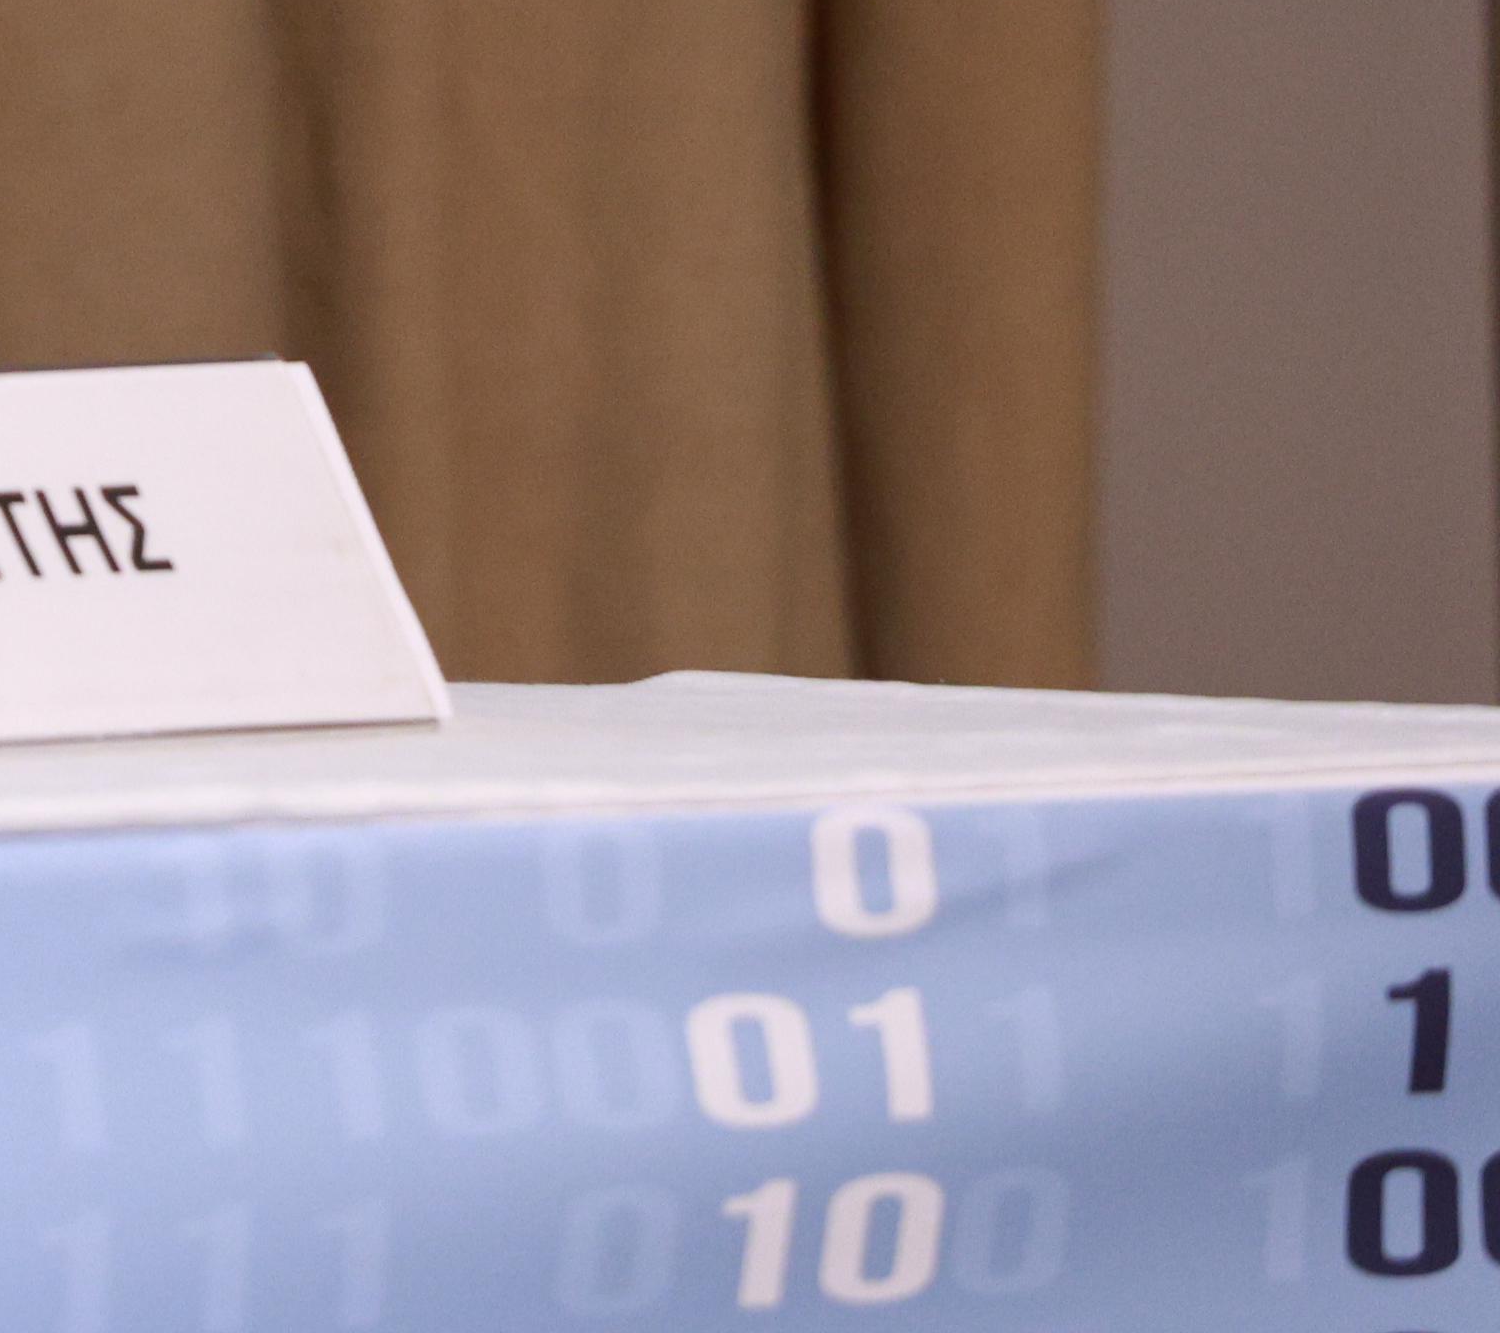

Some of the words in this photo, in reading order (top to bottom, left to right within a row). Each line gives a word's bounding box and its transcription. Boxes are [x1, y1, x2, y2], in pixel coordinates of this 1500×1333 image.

[1352, 786, 1500, 913] 0
[1385, 967, 1452, 1094] 1
[1345, 1146, 1500, 1278] 0
